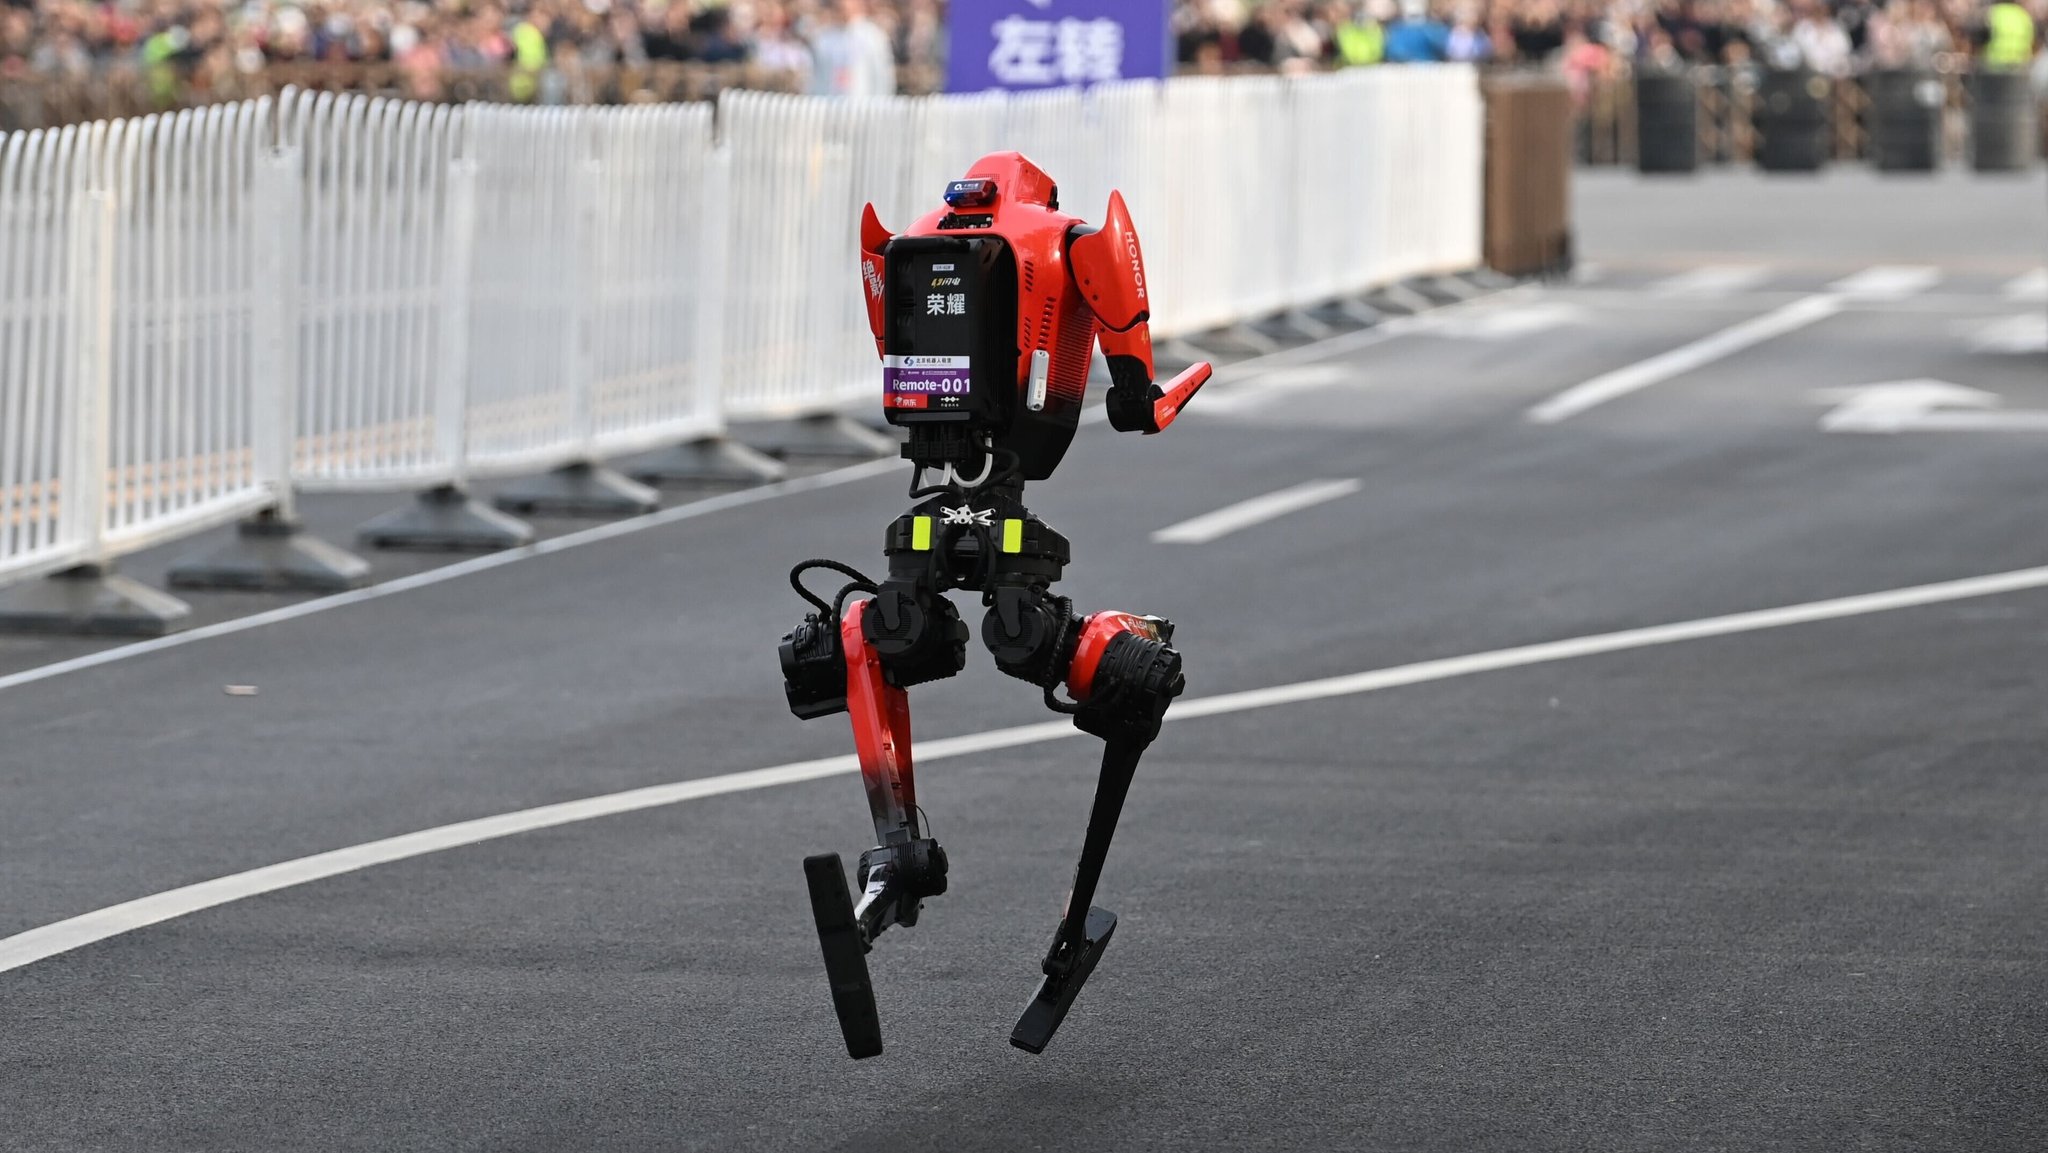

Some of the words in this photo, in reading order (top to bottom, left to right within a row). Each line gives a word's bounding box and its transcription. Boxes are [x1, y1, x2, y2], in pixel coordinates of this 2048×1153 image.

[989, 15, 1123, 83] 左转
[1125, 231, 1145, 299] HONOR
[926, 293, 966, 316] 荣耀
[892, 378, 970, 393] Remote-001
